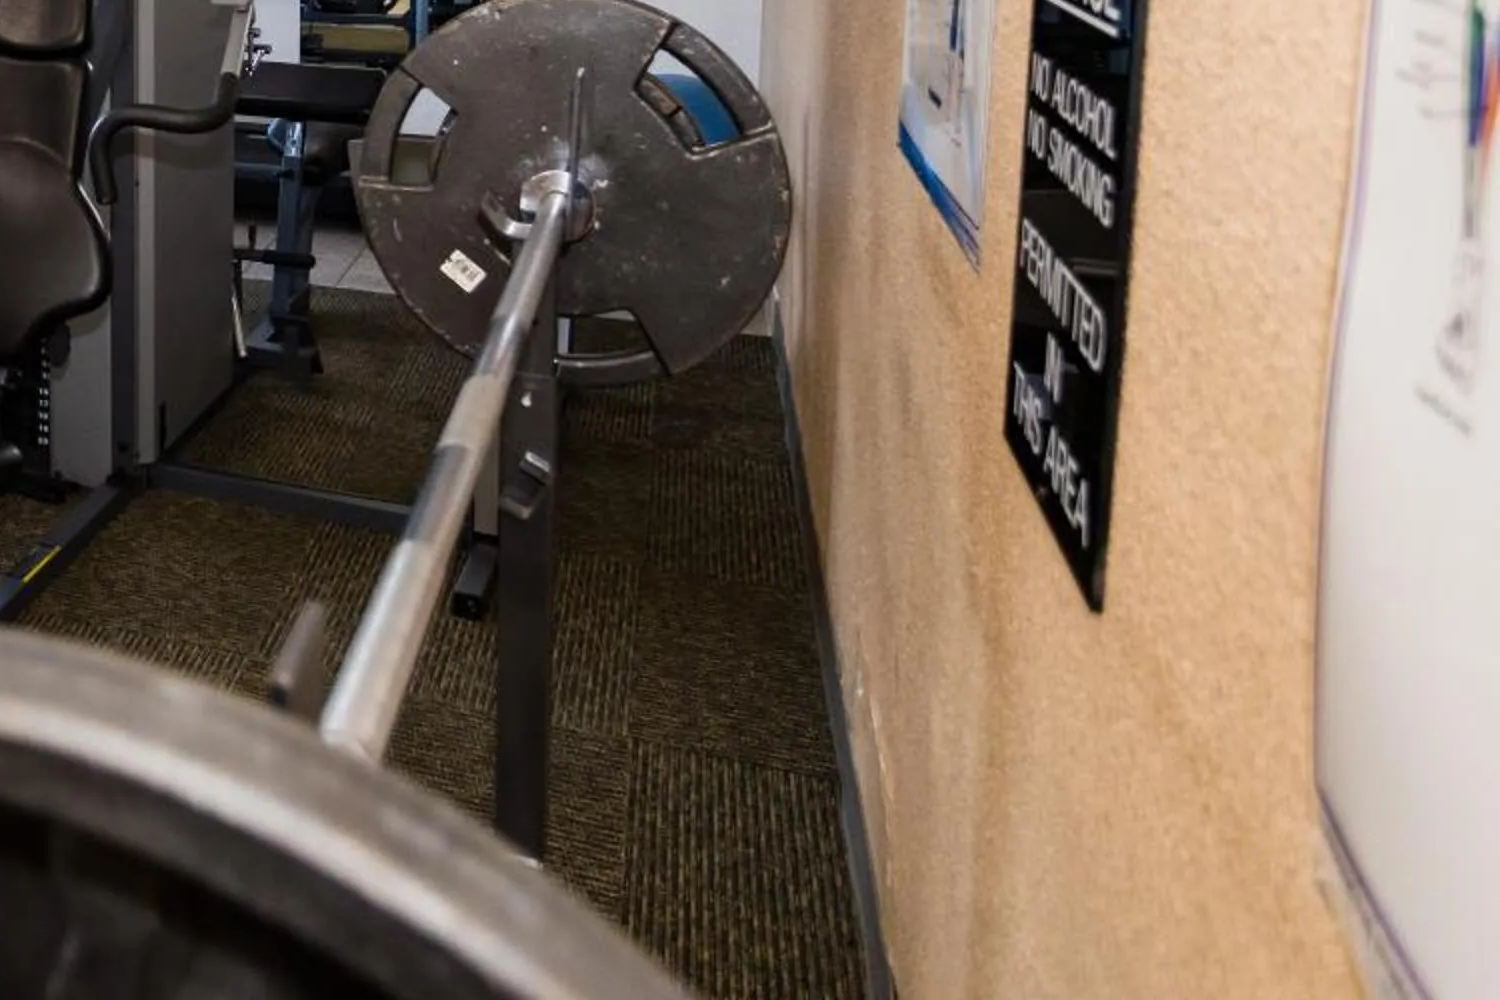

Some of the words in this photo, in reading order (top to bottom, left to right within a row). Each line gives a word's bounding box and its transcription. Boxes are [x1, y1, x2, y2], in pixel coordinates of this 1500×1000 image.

[1031, 52, 1051, 102] NO
[1051, 68, 1117, 160] ALCOHOL
[1028, 110, 1047, 160] NO
[1048, 128, 1116, 228] SMOKING
[1019, 217, 1109, 372] PERMITTED
[1043, 330, 1065, 403] IN
[1013, 360, 1044, 455] THIS
[1043, 425, 1091, 548] AREA
